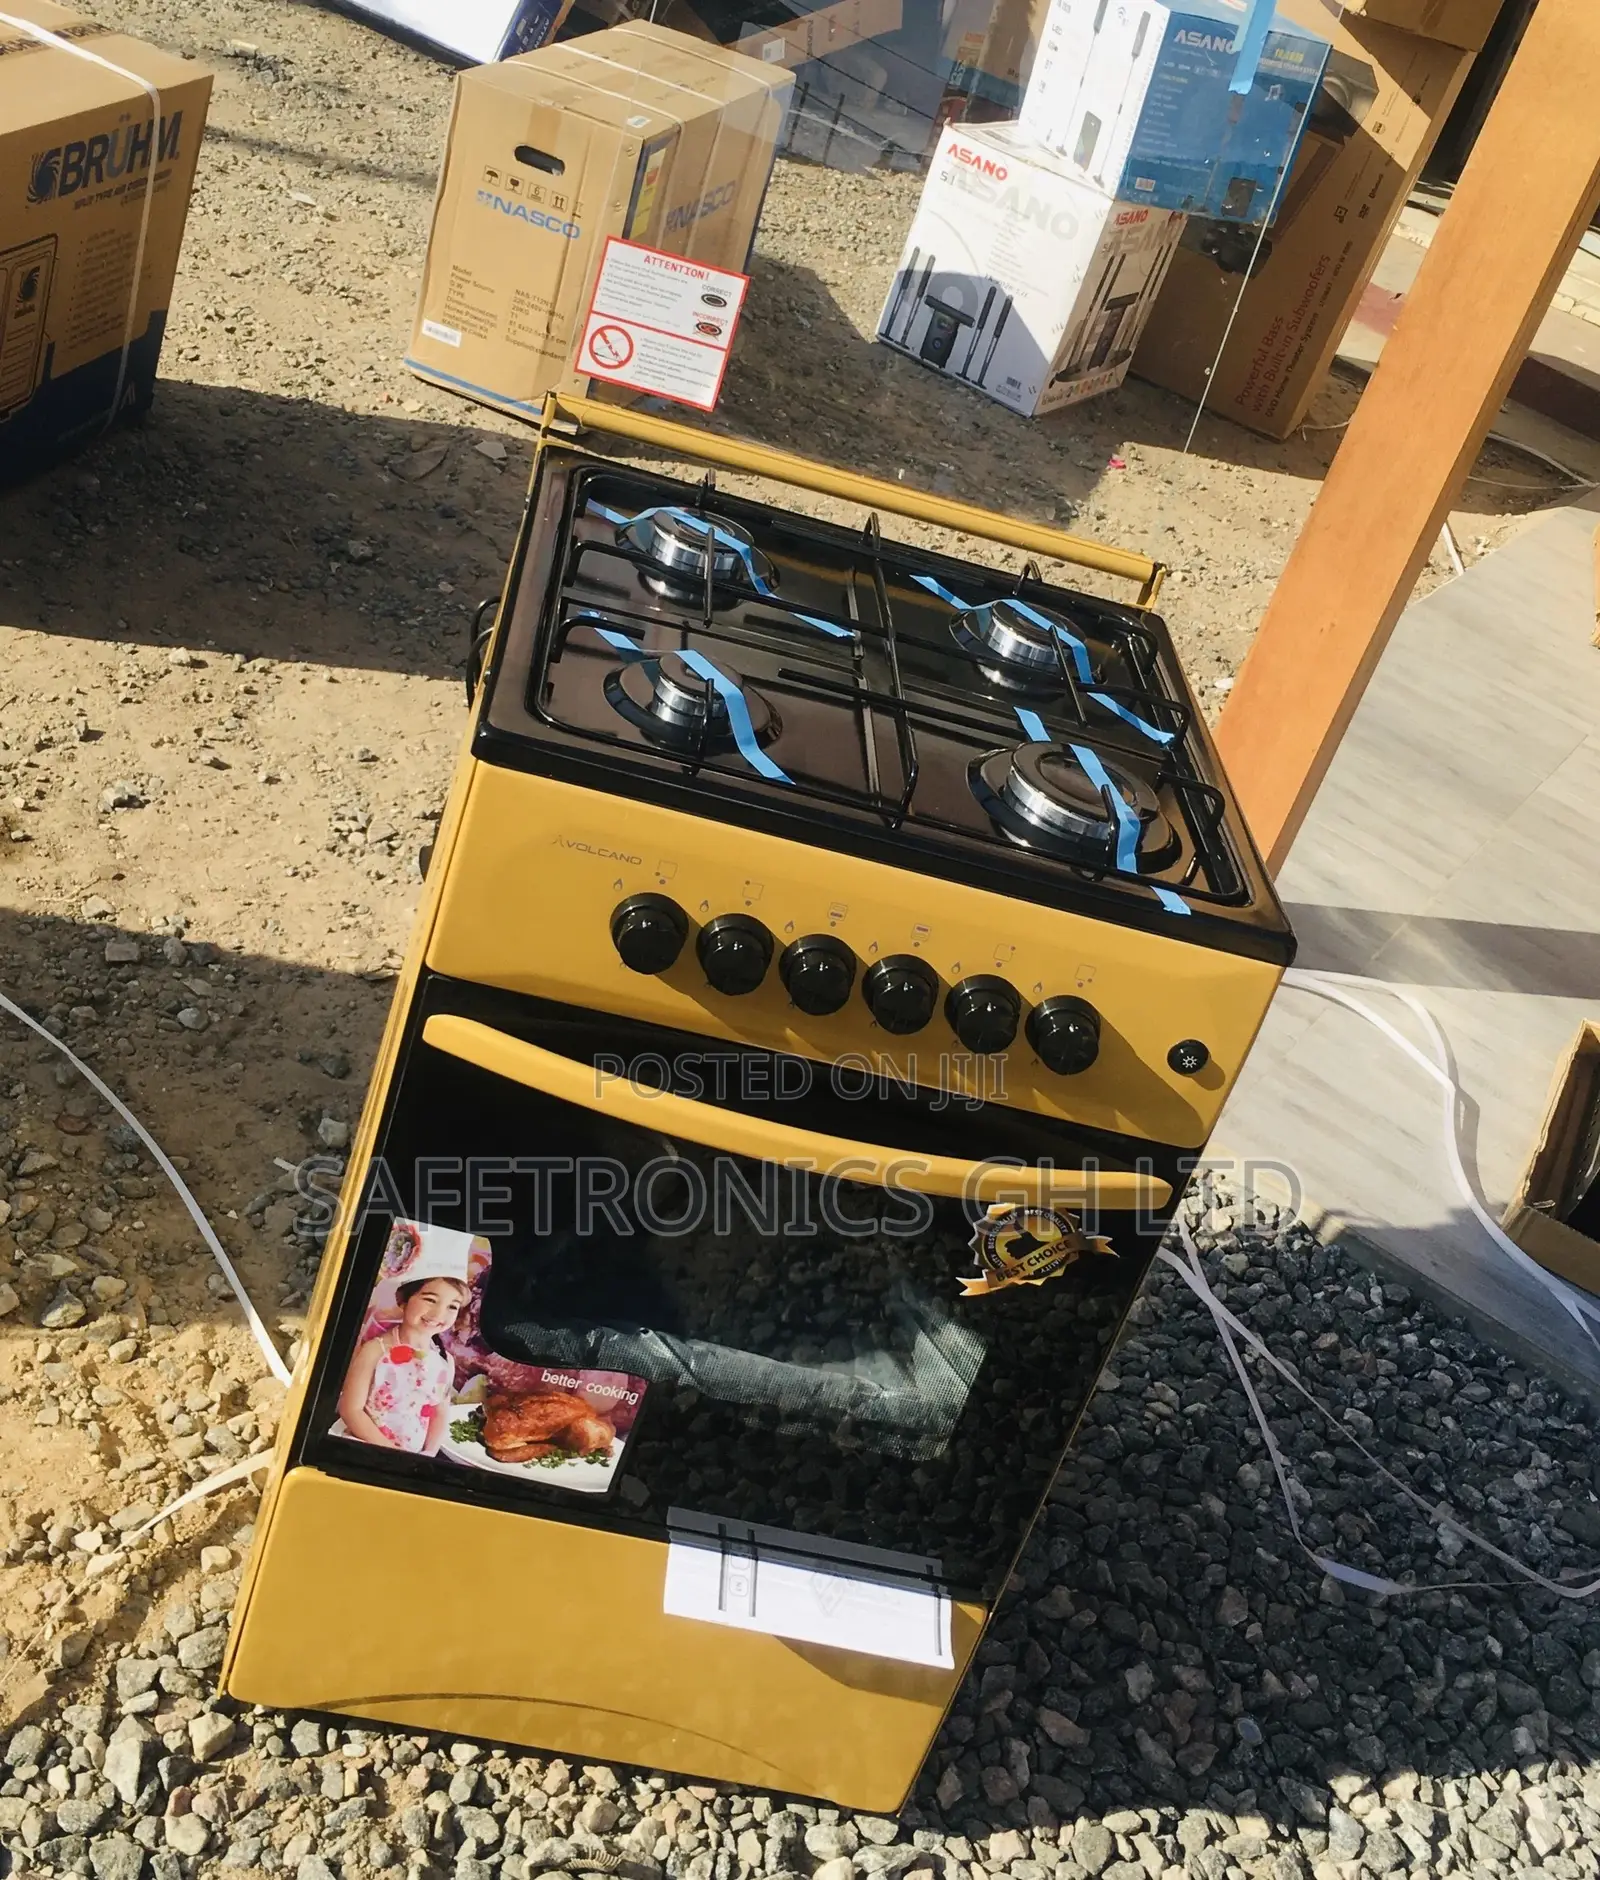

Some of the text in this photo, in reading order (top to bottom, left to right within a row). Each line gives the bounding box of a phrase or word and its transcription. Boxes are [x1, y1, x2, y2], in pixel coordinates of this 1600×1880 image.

[1174, 29, 1236, 55] ASANO
[58, 110, 183, 197] BRÜHM
[947, 143, 1008, 181] ASANO
[493, 196, 581, 240] NASCO
[1115, 209, 1149, 225] ASANO
[644, 255, 710, 281] ATTENTION!
[701, 284, 733, 298] CORRECT
[1251, 384, 1268, 413] with
[1264, 332, 1293, 383] Built-in
[1286, 254, 1331, 334] Subwoofers
[1235, 315, 1284, 406] Powerful Bass
[566, 840, 643, 866] VOLCANO
[996, 1239, 1072, 1282] BEST CHOICE
[541, 1369, 639, 1405] better cooking
